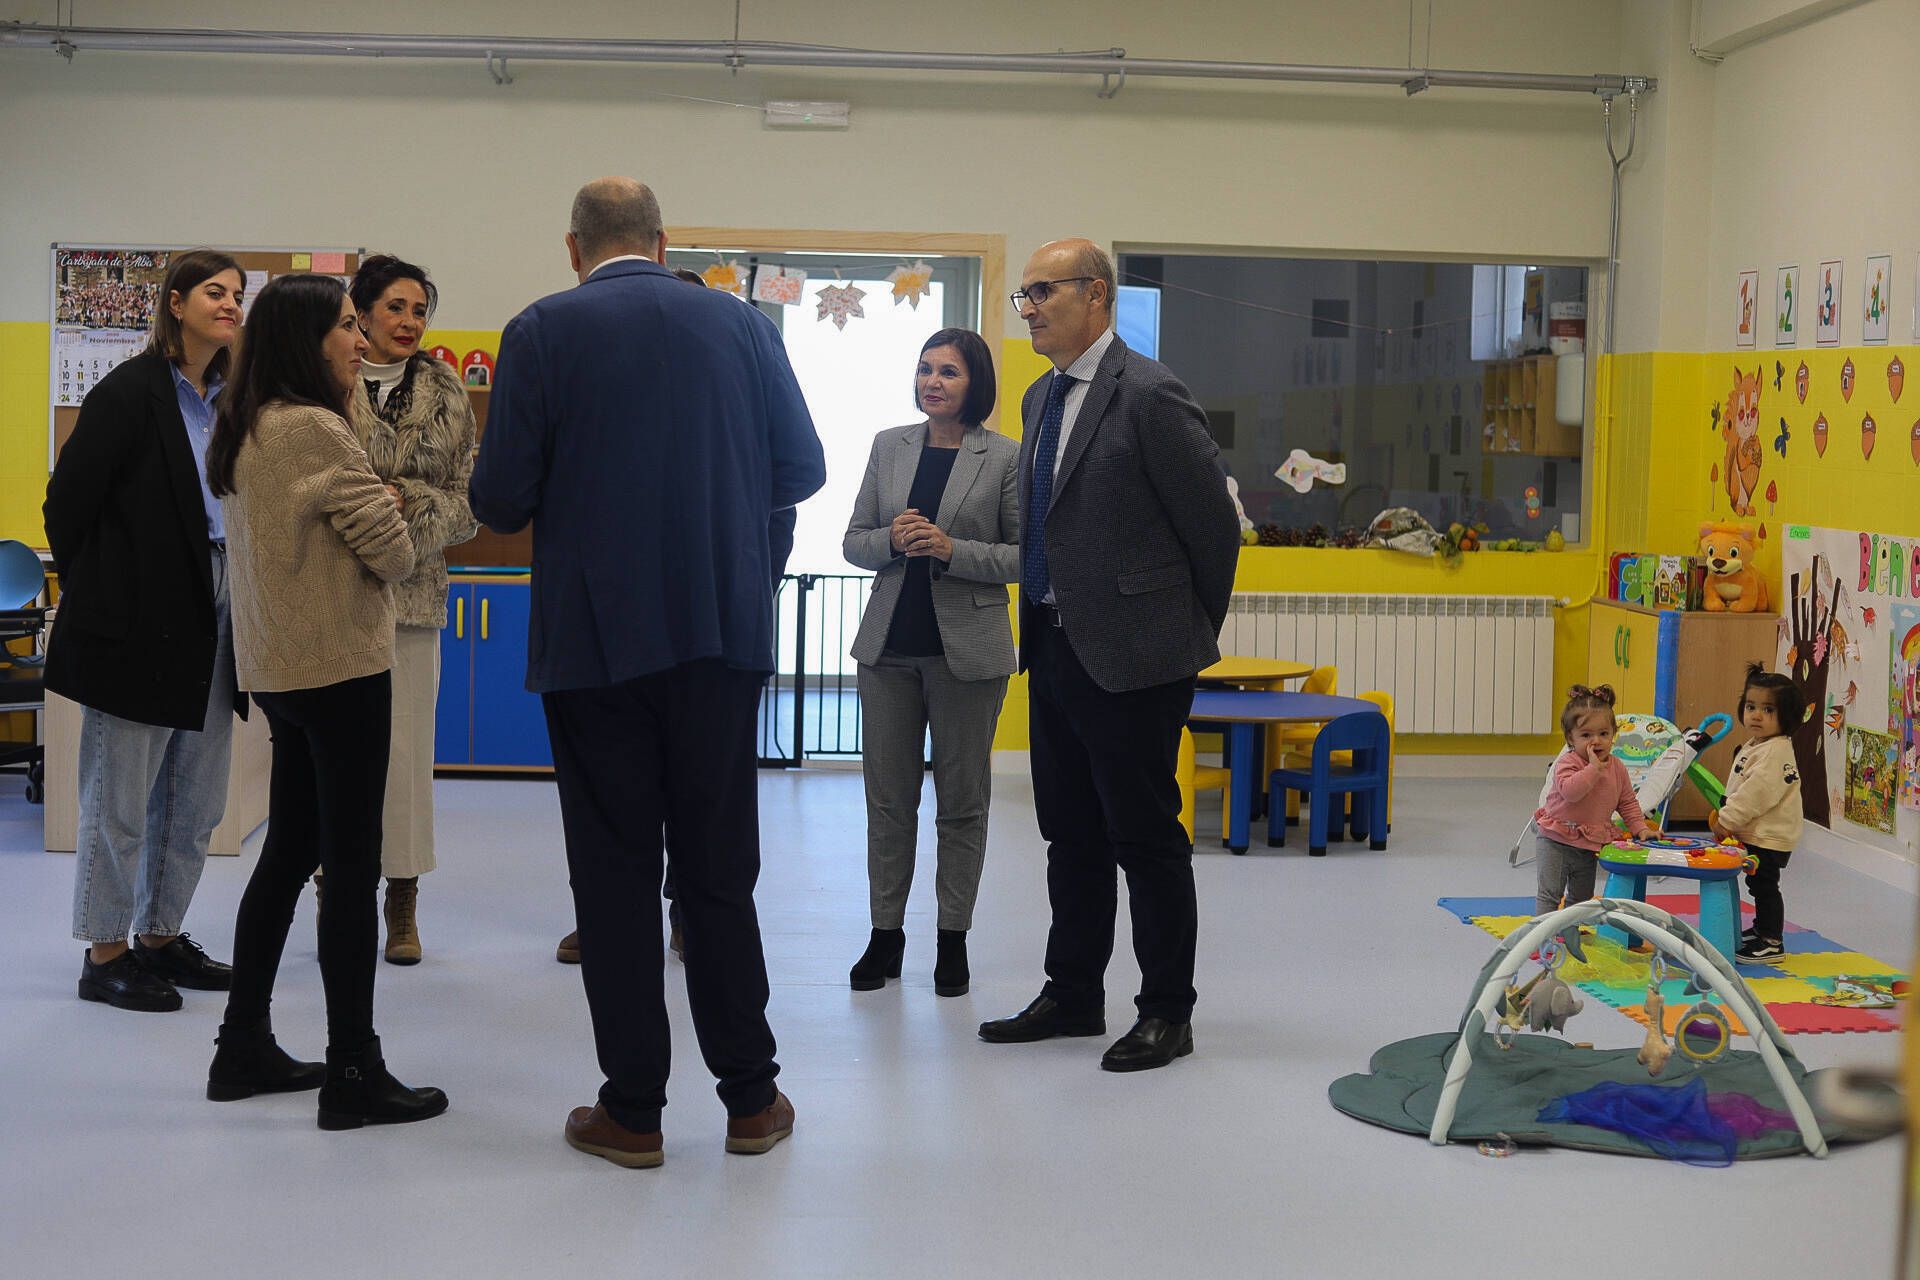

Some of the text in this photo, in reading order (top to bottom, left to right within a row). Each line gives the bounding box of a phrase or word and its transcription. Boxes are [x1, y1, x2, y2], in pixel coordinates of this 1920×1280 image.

[110, 256, 122, 266] de
[128, 255, 153, 268] Alba
[1739, 279, 1749, 334] 1
[1824, 282, 1833, 326] 3
[1870, 281, 1881, 326] 4
[1784, 289, 1793, 332] 2
[63, 360, 113, 369] 3 4 5 6
[62, 371, 99, 380] 10 11 12
[62, 383, 85, 392] 17 18
[61, 394, 70, 403] 24
